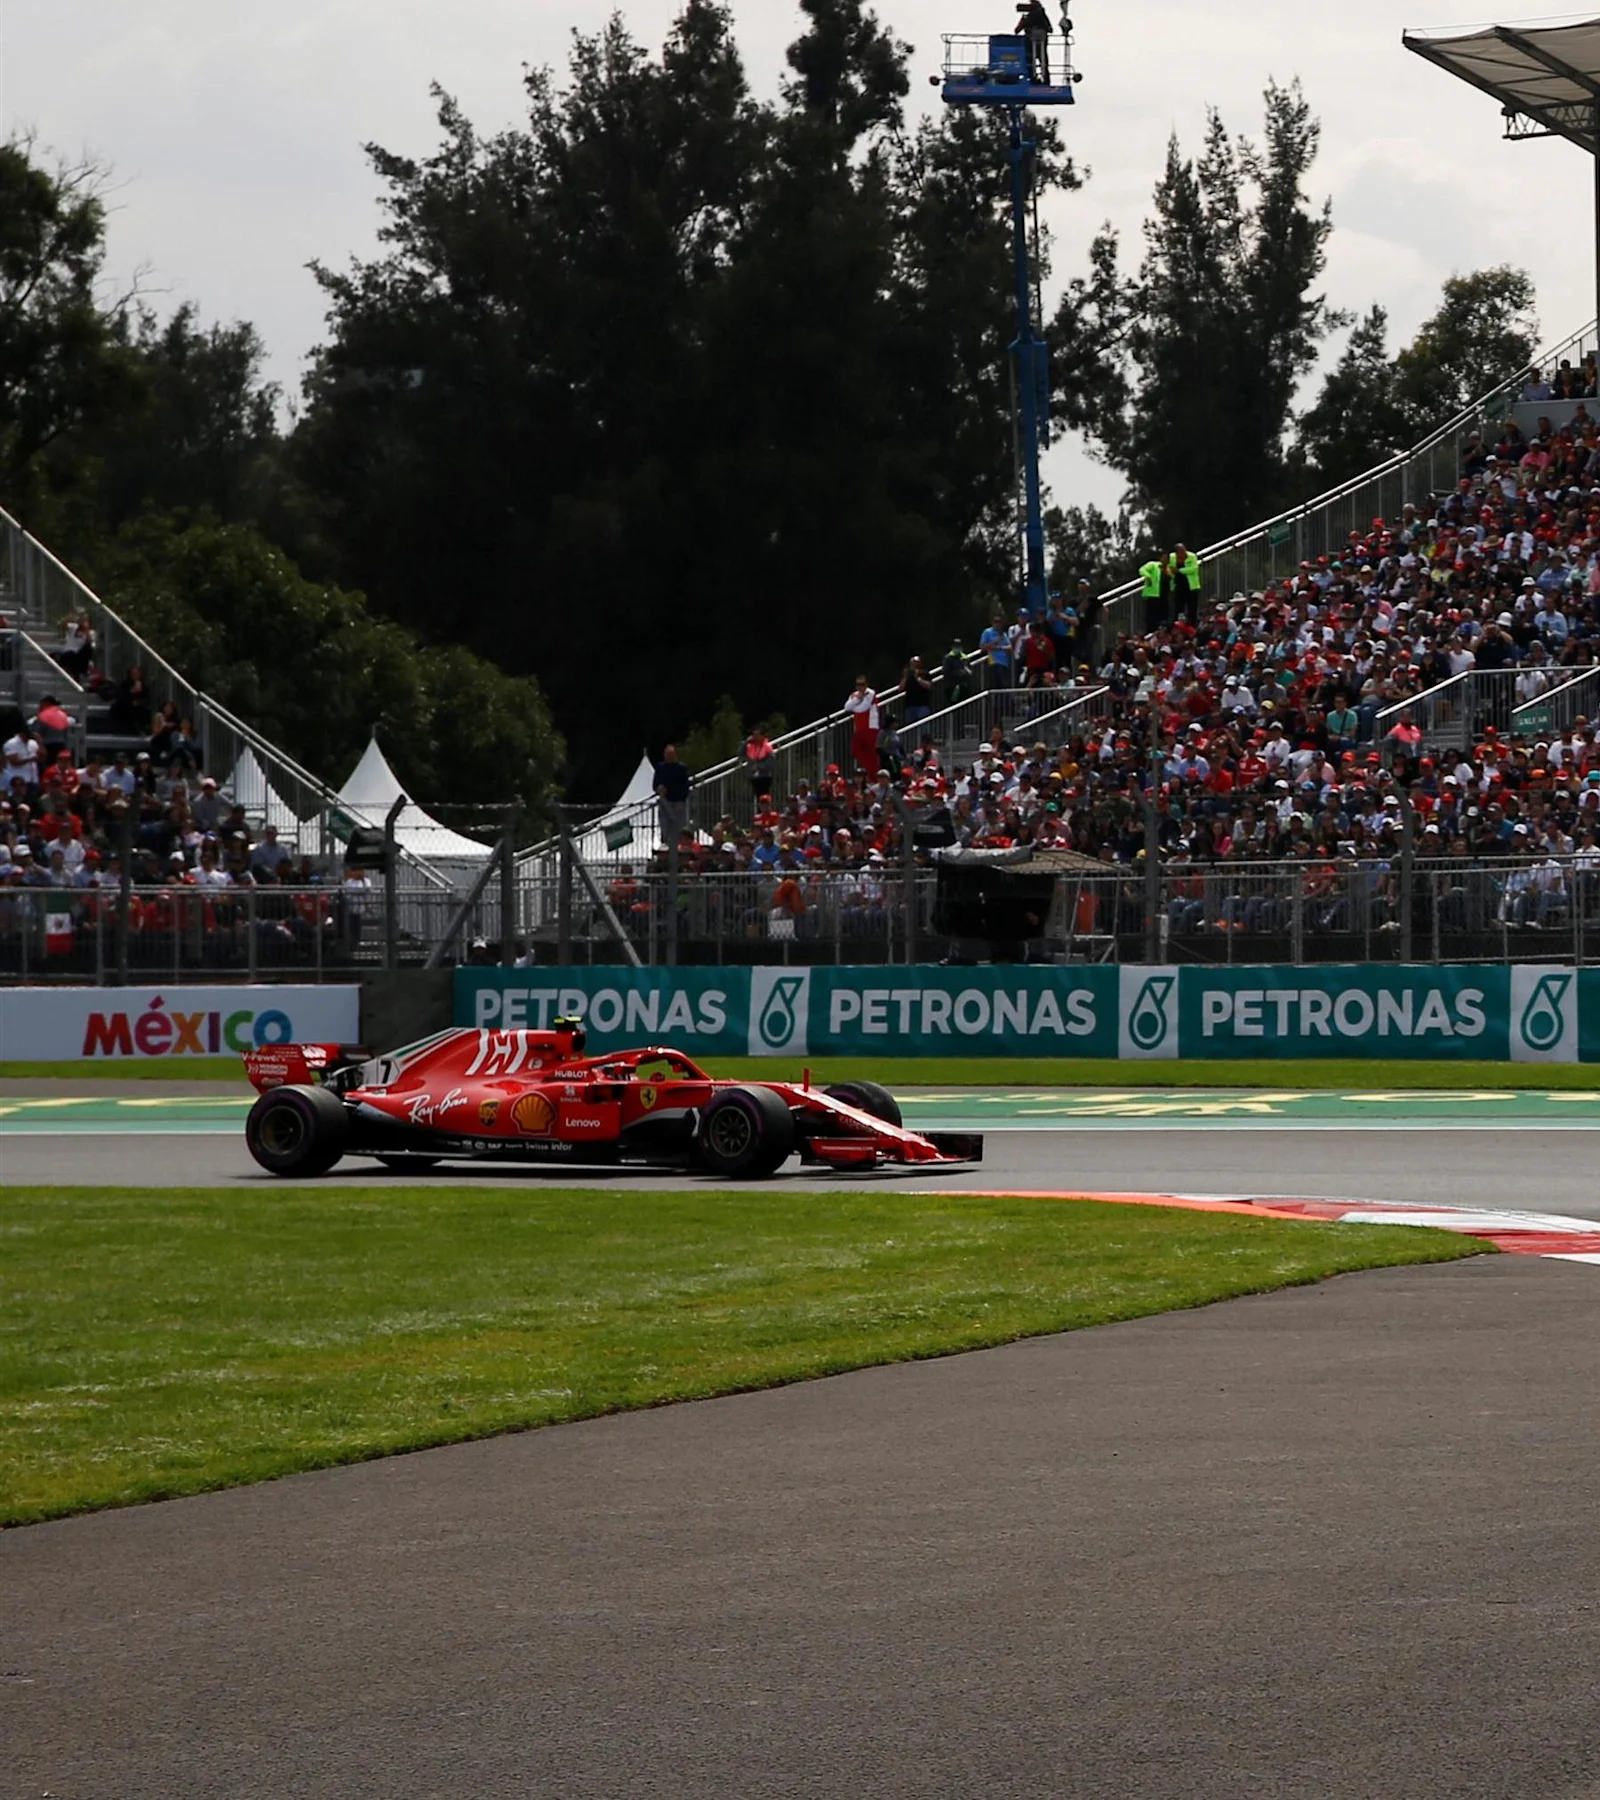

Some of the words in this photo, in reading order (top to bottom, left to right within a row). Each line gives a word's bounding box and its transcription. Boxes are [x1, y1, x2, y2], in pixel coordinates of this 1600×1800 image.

[475, 988, 727, 1034] PETRONAS
[830, 989, 1096, 1036] PETRONAS
[1202, 988, 1486, 1037] PETRONAS
[379, 1060, 392, 1084] 7
[554, 1070, 588, 1079] HUBLOT
[565, 1117, 601, 1128] Lenovo
